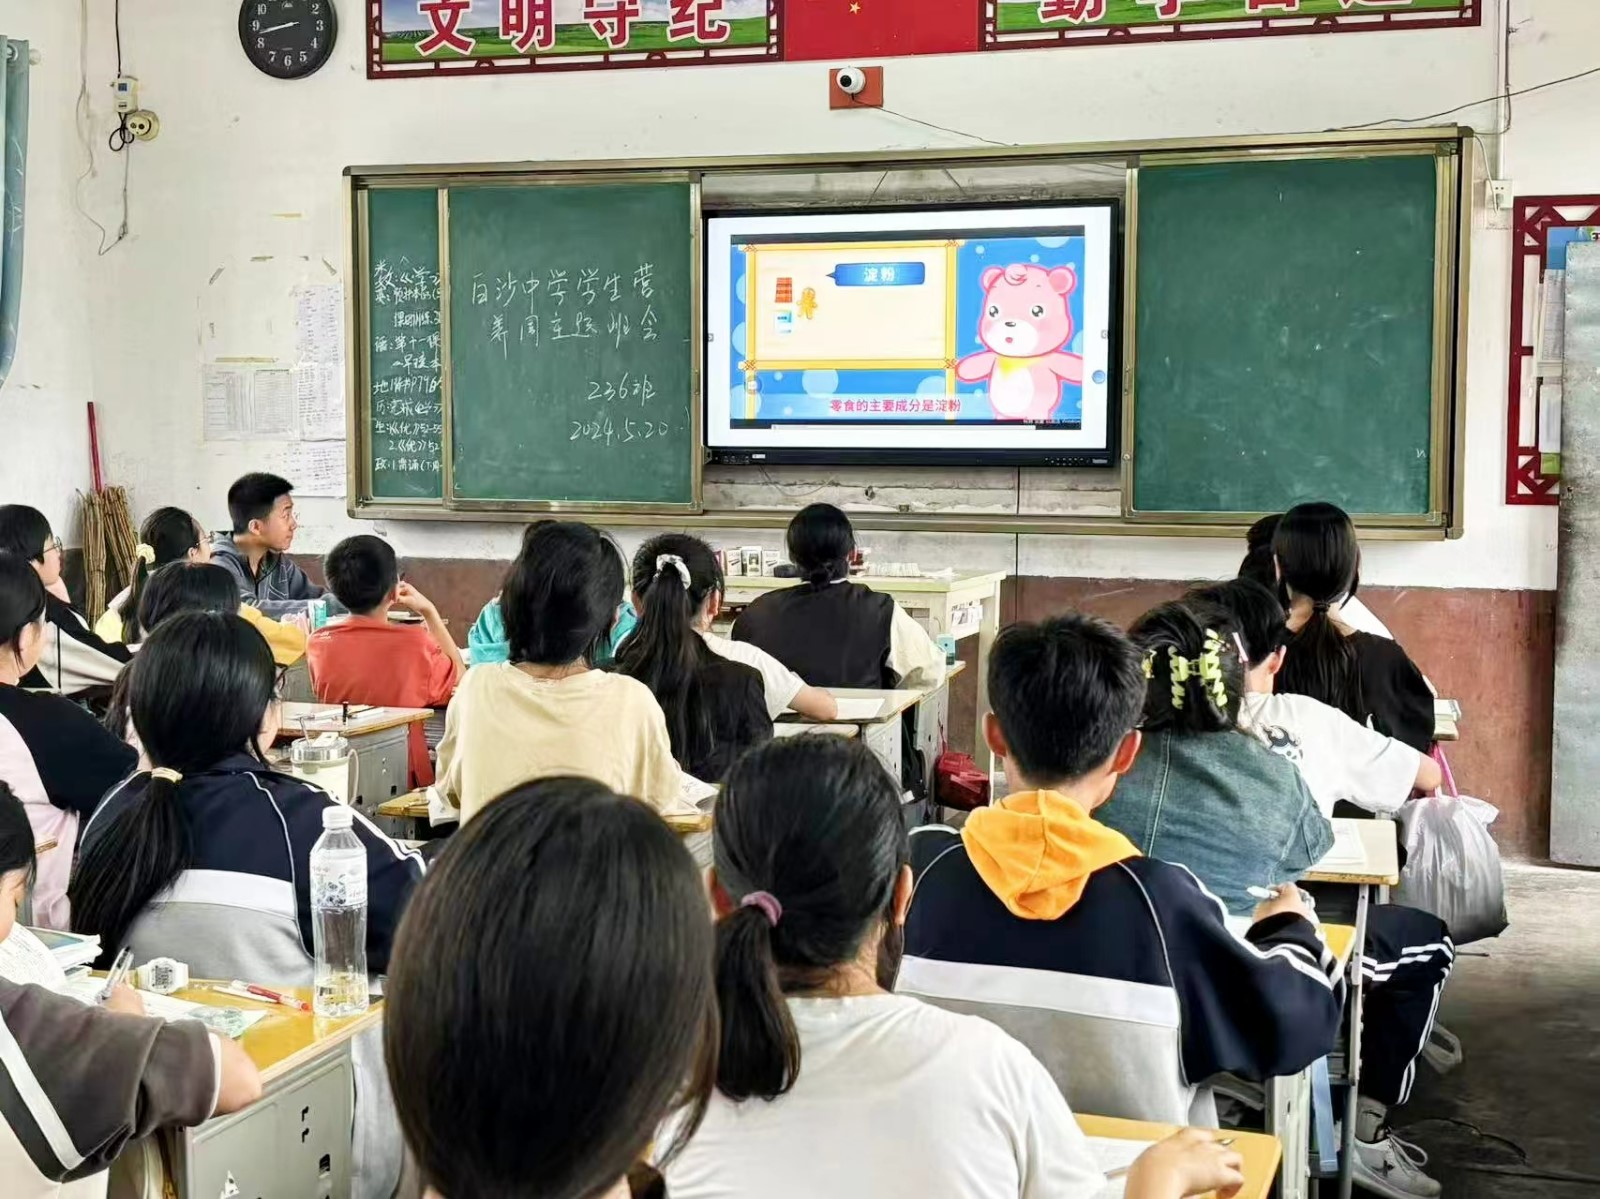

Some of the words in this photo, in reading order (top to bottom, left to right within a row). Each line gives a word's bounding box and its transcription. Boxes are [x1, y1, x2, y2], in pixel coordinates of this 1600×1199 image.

[257, 3, 267, 15] 10
[311, 3, 320, 15] 2
[252, 20, 260, 32] 9
[316, 20, 324, 31] 3
[257, 37, 265, 49] 8
[310, 37, 317, 49] 4
[268, 51, 276, 62] 7
[284, 55, 292, 67] 6
[299, 51, 307, 62] 5
[864, 266, 896, 283] 淀粉
[472, 263, 655, 314] 白沙中学学生营
[490, 304, 658, 360] 养周主题班会
[587, 372, 656, 406] 236班
[830, 398, 961, 413] 零食的主要成分是淀粉
